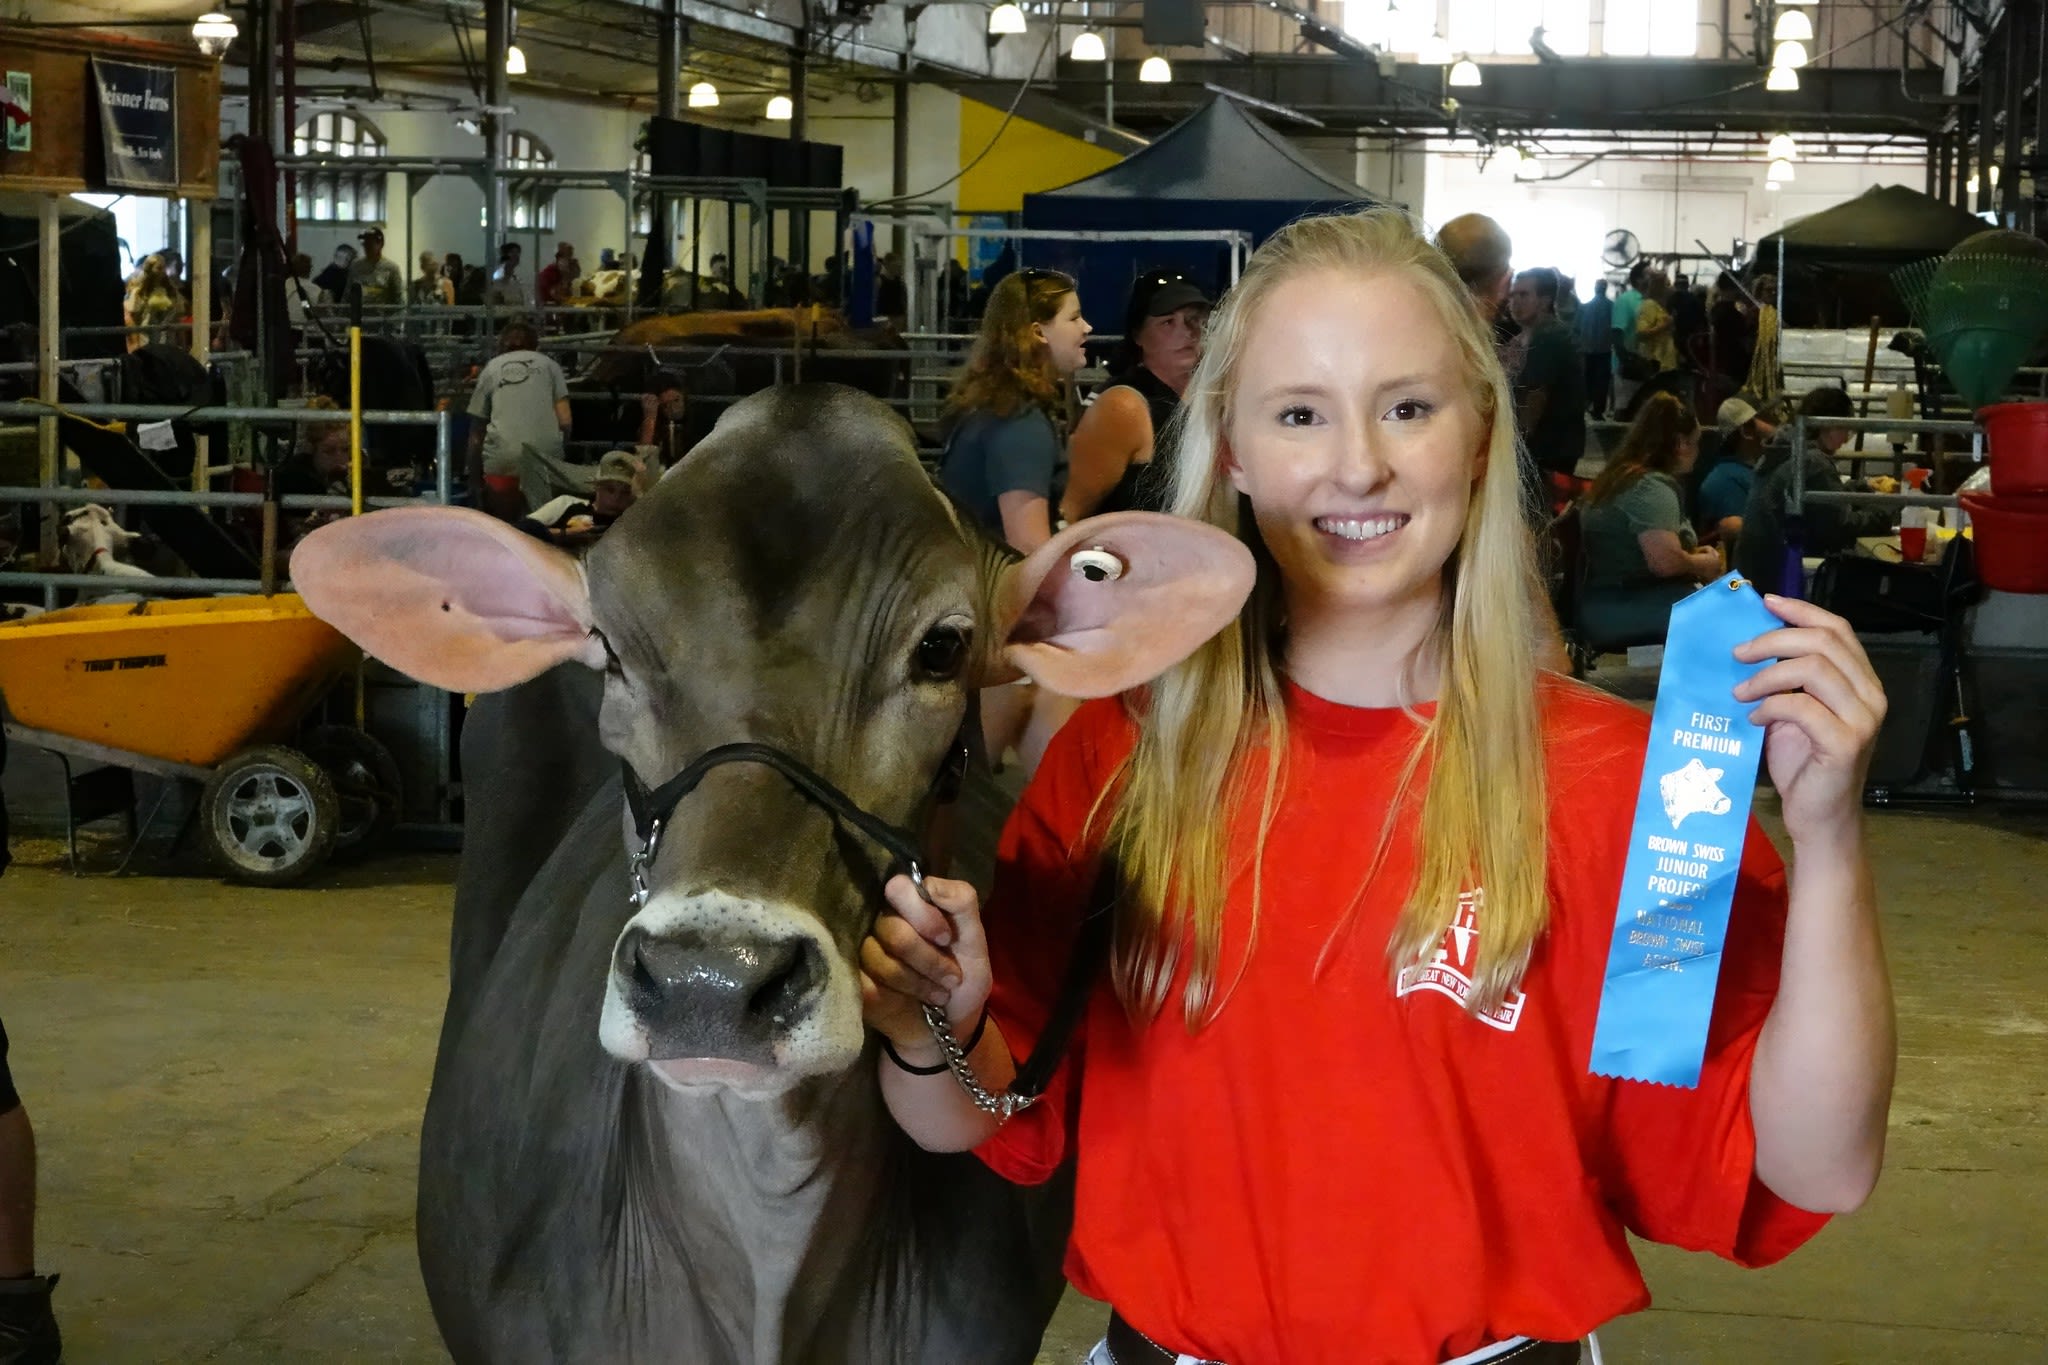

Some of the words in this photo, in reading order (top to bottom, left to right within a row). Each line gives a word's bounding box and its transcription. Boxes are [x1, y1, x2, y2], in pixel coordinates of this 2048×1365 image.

[1691, 711, 1732, 733] FIRST
[1672, 729, 1741, 756] PREMIUM
[1647, 834, 1688, 856] BROWN
[1692, 843, 1725, 862] SWISS
[1656, 856, 1708, 879] JUNIOR
[1647, 875, 1708, 900] PROJECT
[1636, 910, 1704, 936] NATIONAL
[1628, 930, 1669, 949] BROWN
[1673, 938, 1705, 956] SWISS
[1441, 972, 1457, 989] NEW
[1493, 1006, 1513, 1023] FAIR
